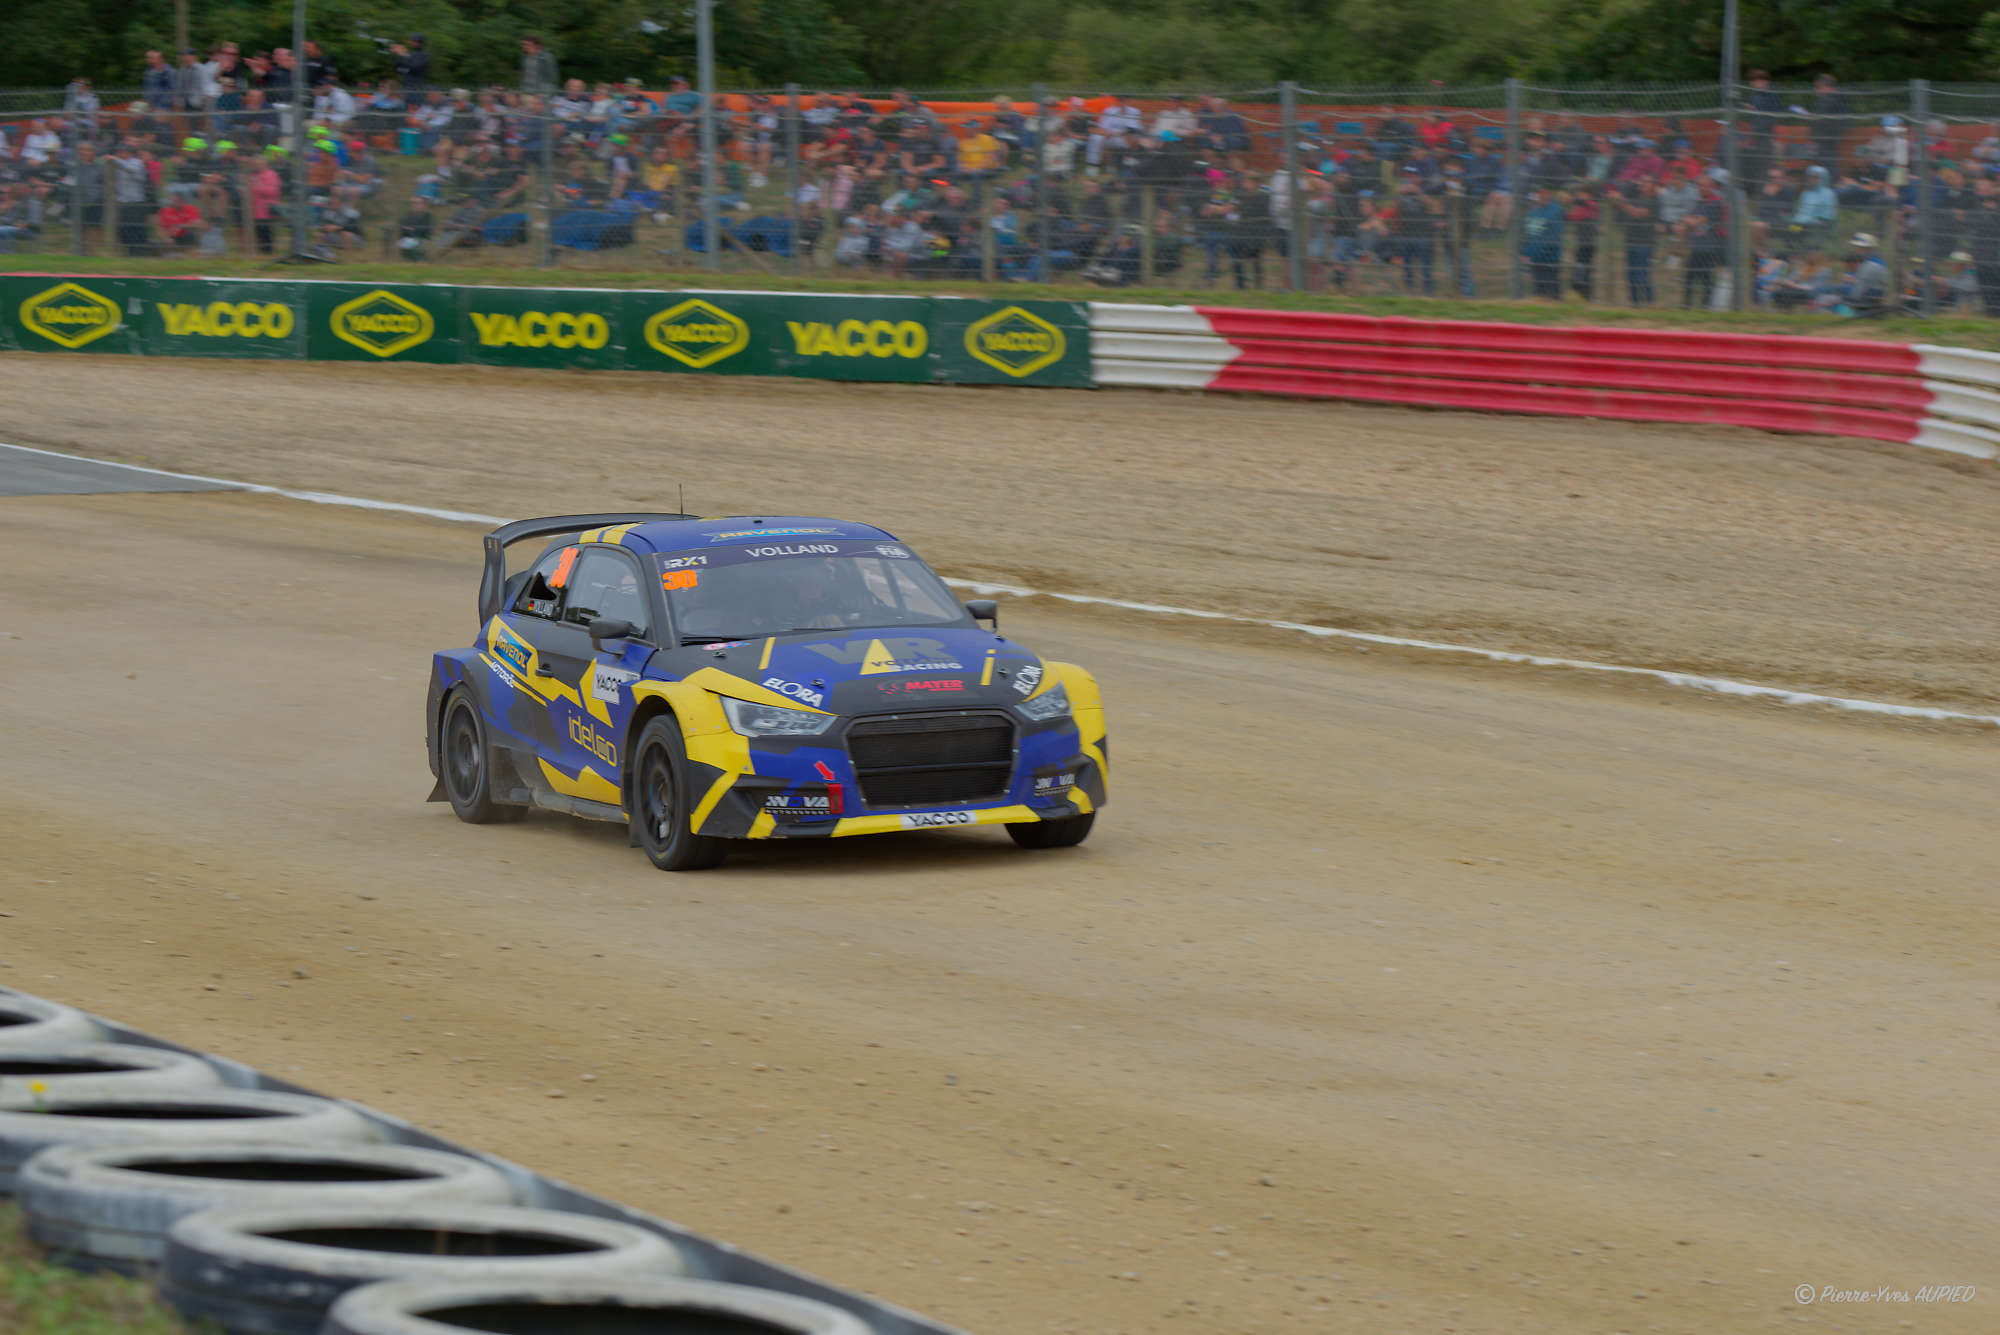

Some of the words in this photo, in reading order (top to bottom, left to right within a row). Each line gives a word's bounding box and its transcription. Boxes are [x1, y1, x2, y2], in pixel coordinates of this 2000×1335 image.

[36, 305, 107, 325] YACCO
[156, 301, 294, 339] YACCO
[346, 312, 420, 334] YACCO
[470, 311, 609, 350] YACCO
[660, 323, 736, 343] YACCO
[785, 319, 928, 359] YACCO
[981, 331, 1050, 352] YACCO
[745, 544, 839, 557] VOLLAND
[662, 569, 698, 590] 30
[762, 677, 825, 707] ELORA
[904, 679, 965, 691] MAYER
[907, 812, 969, 826] YACCO
